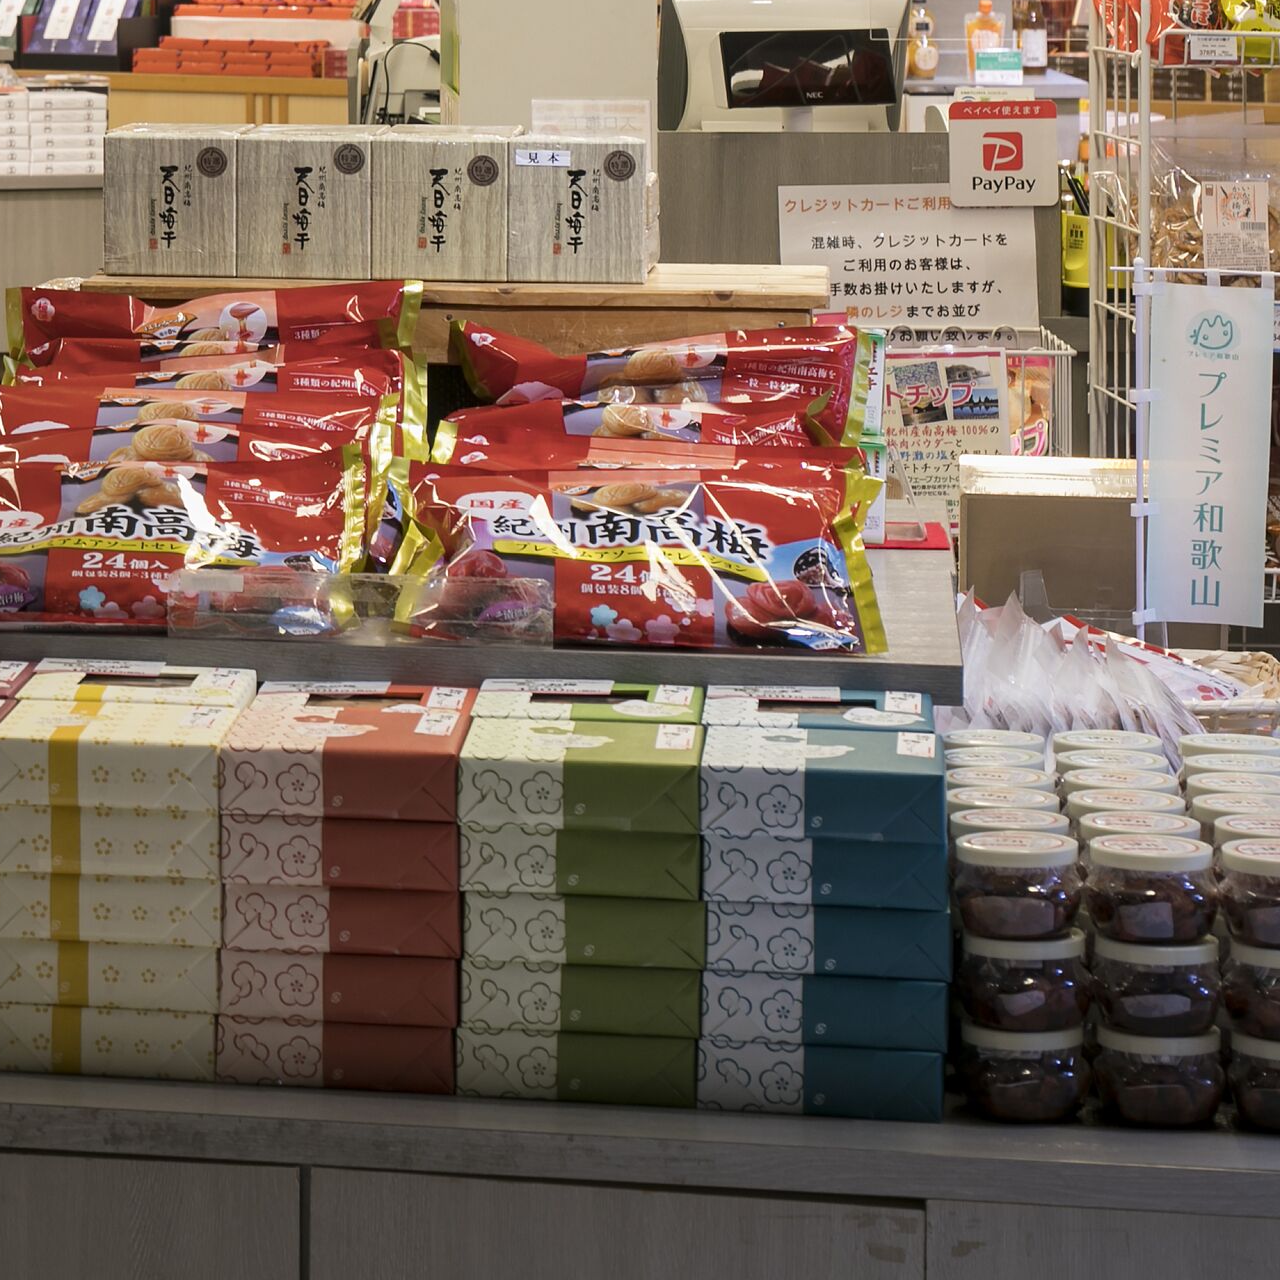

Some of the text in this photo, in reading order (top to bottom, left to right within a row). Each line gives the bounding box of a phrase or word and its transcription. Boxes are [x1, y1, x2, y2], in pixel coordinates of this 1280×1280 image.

[806, 91, 824, 99] NEC
[963, 105, 1042, 116] ペイペイ使えます
[528, 152, 560, 165] 見本
[972, 176, 1036, 193] PayPay
[785, 196, 1014, 213] クレジットカードご利用
[811, 233, 1008, 249] 混雑時、クレジットカードを
[843, 257, 973, 272] ご利用のお客様は、
[847, 304, 981, 319] 隣のレジまでお並び
[886, 425, 958, 437] 紀州産南高梅
[1191, 369, 1228, 609] プレミア和歌山
[469, 498, 526, 511] 国産
[82, 552, 169, 570] 24個入
